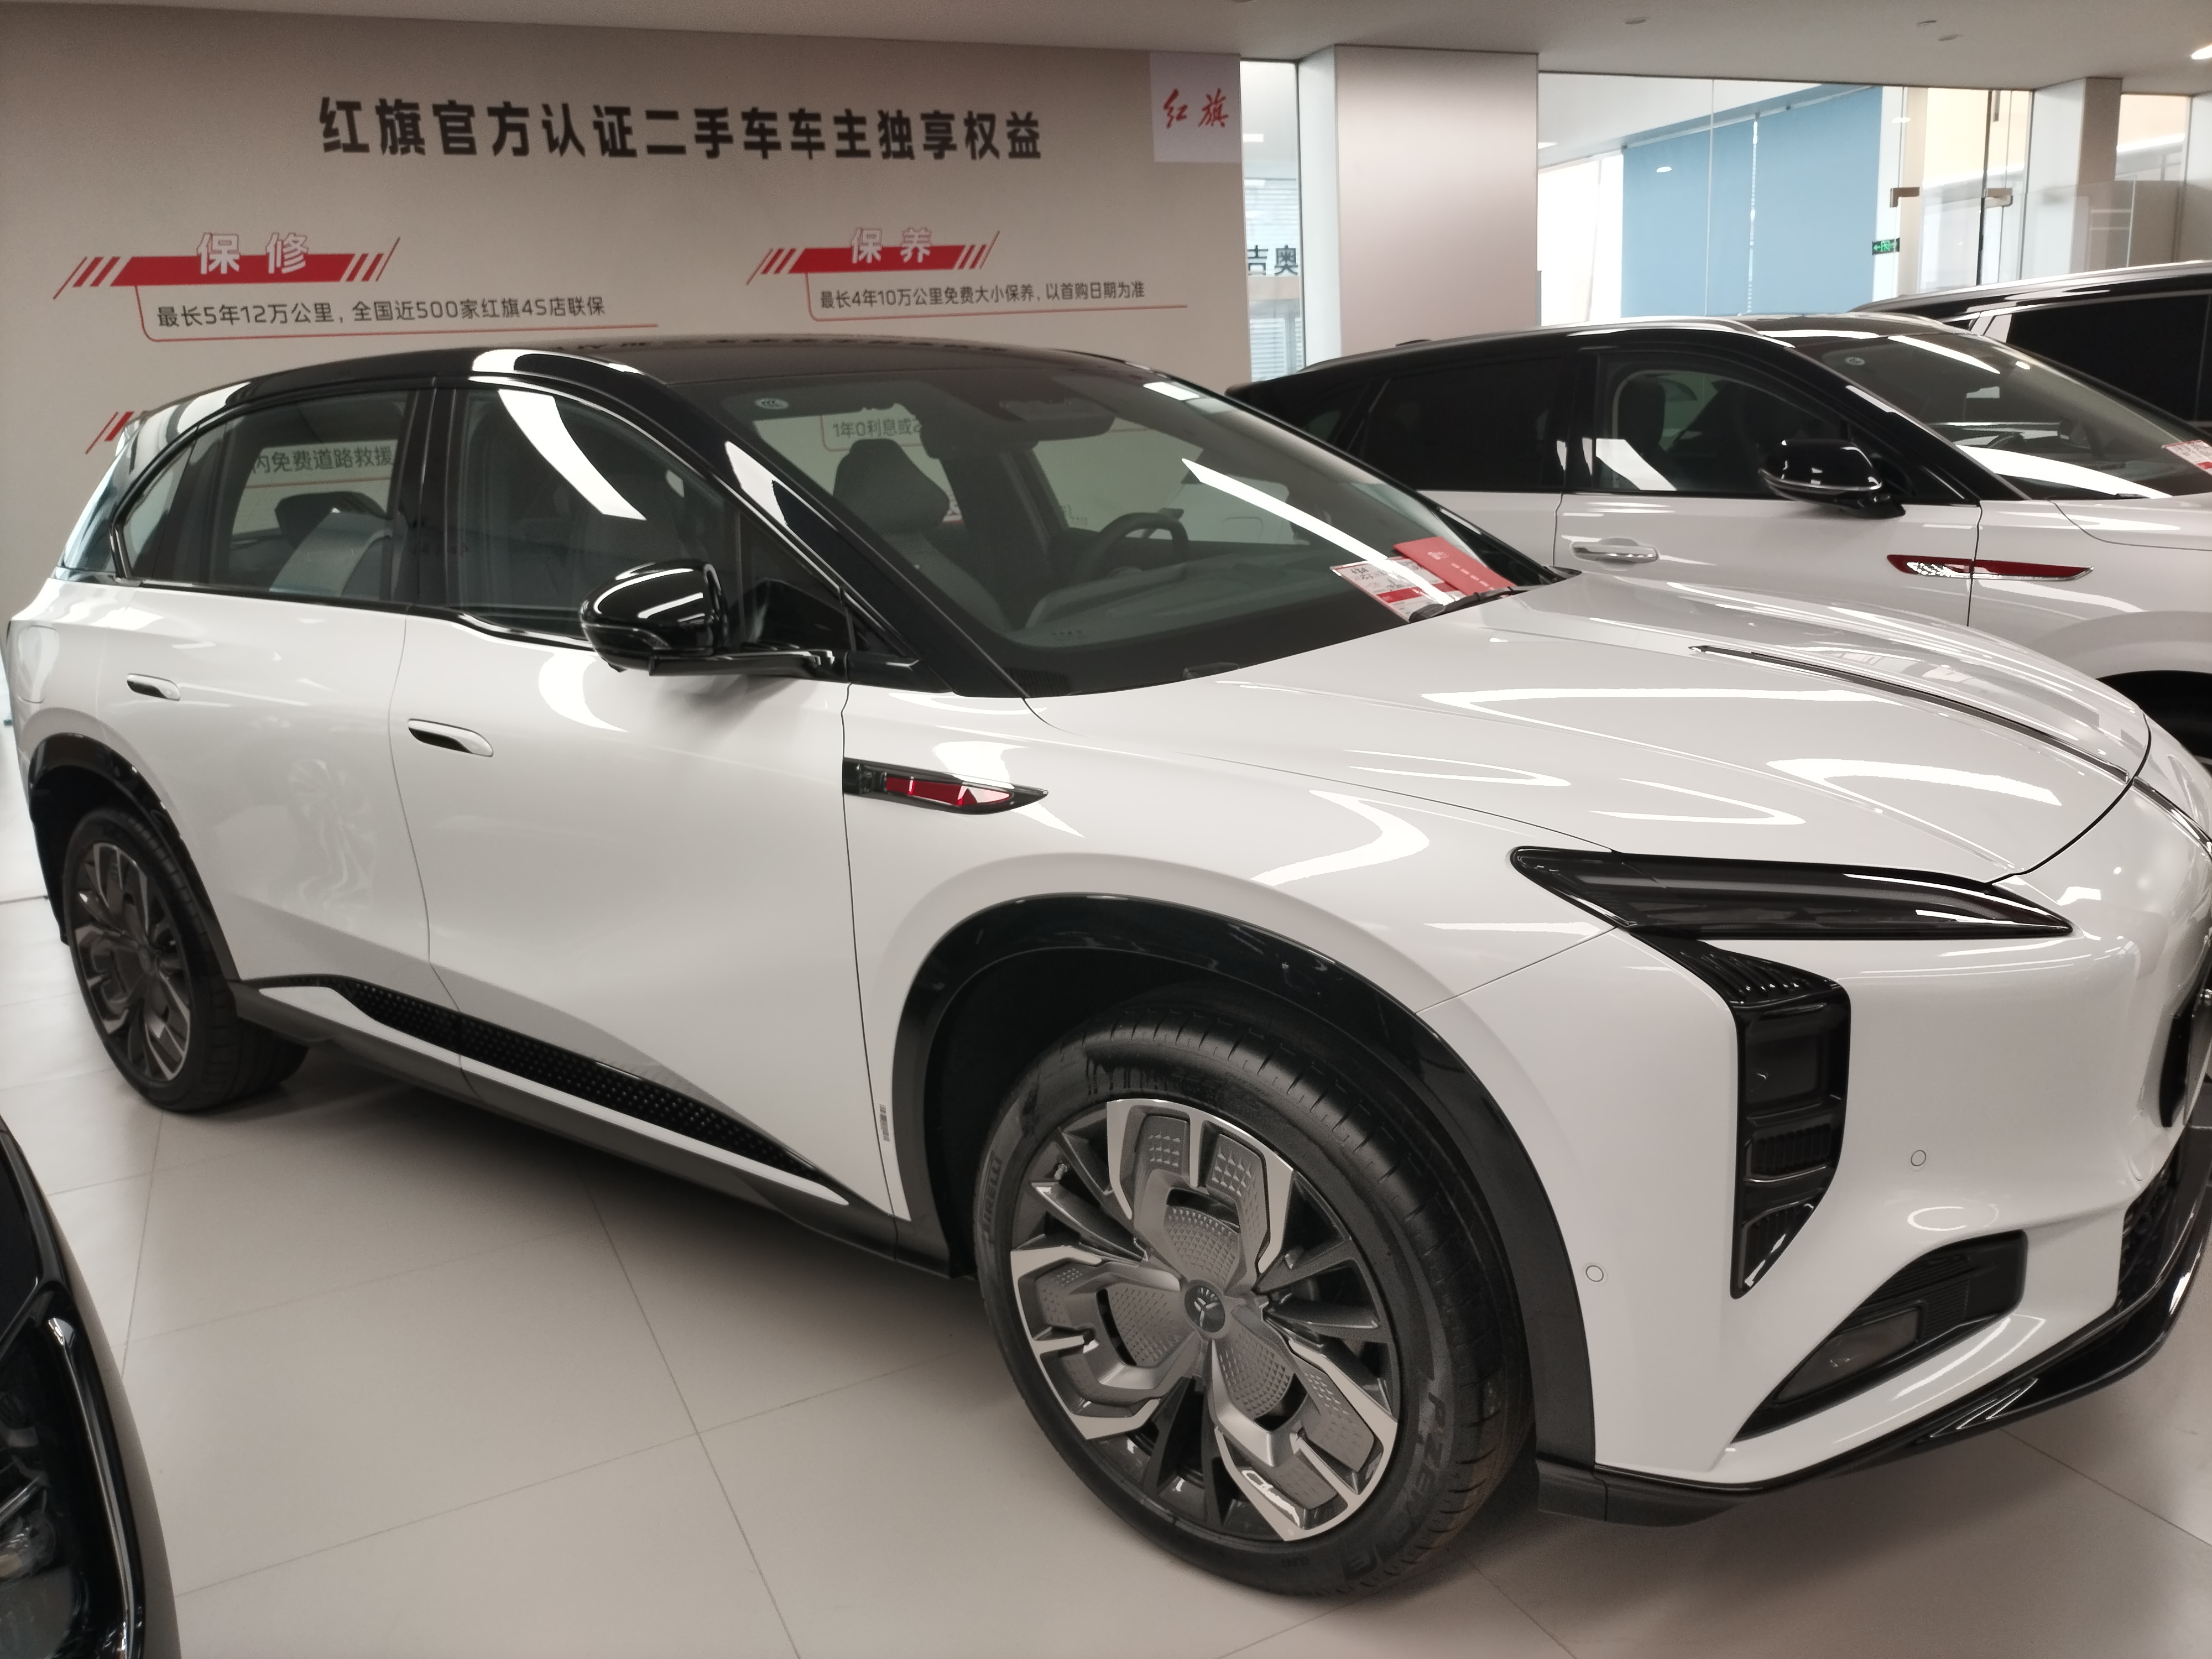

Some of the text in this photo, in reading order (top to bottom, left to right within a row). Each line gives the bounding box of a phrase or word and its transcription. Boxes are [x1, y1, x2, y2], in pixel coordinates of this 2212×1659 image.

[319, 97, 1041, 159] 红旗官方认证二手车车主独享权益
[1163, 88, 1229, 129] 红旗
[198, 232, 310, 275] 保修
[851, 227, 933, 265] 保养
